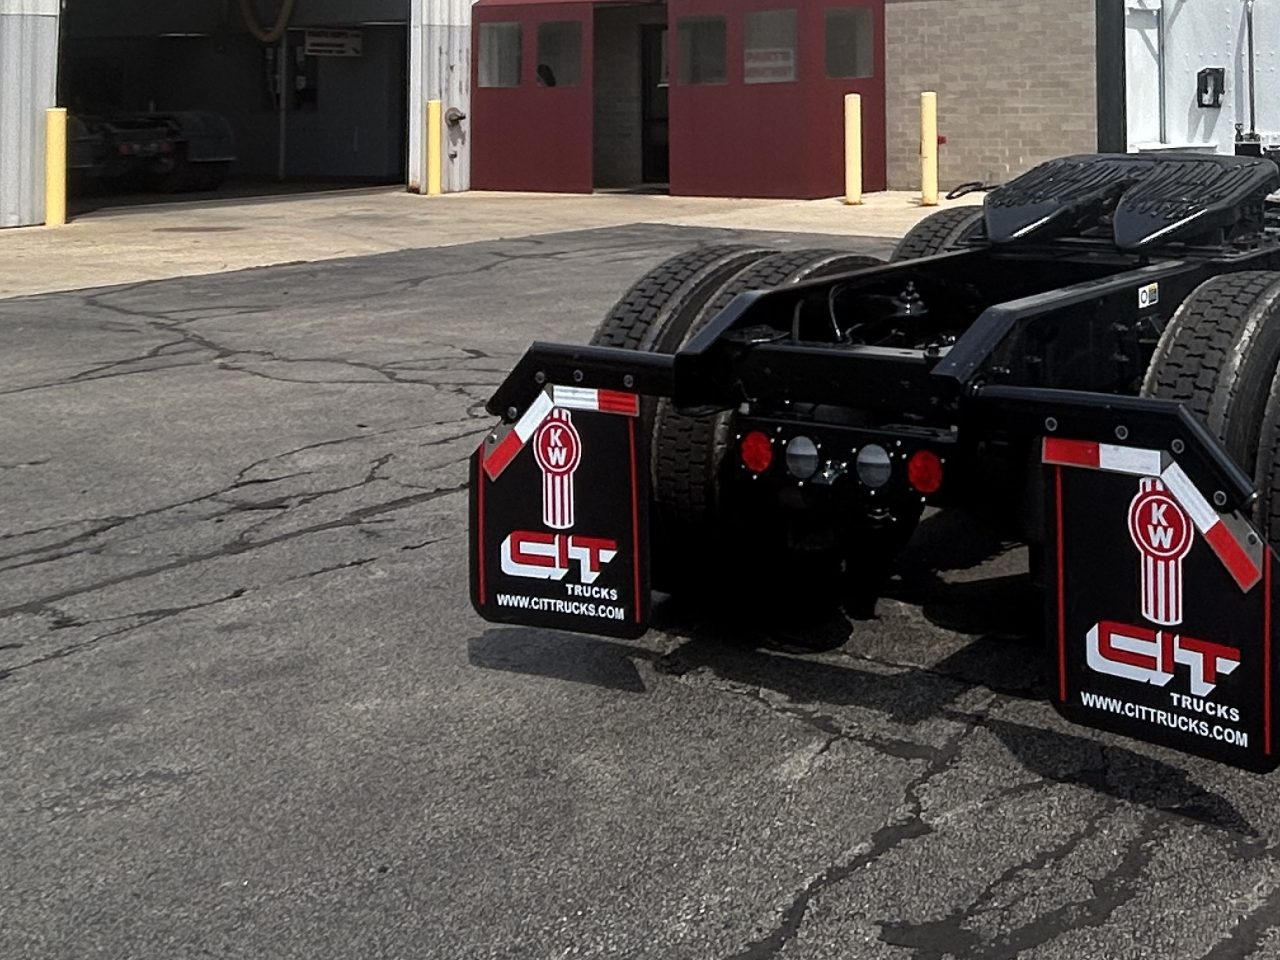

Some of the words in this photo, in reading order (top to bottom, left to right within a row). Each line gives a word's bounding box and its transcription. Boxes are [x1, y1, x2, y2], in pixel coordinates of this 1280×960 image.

[501, 530, 619, 584] CIT
[497, 594, 625, 620] WWW.CITTRUCKS.COM
[565, 583, 618, 600] TRUCKS
[1086, 620, 1241, 697] CIT
[1080, 691, 1249, 748] WWW.CITTRUCKS.COM
[1169, 692, 1240, 721] TRUCKS
